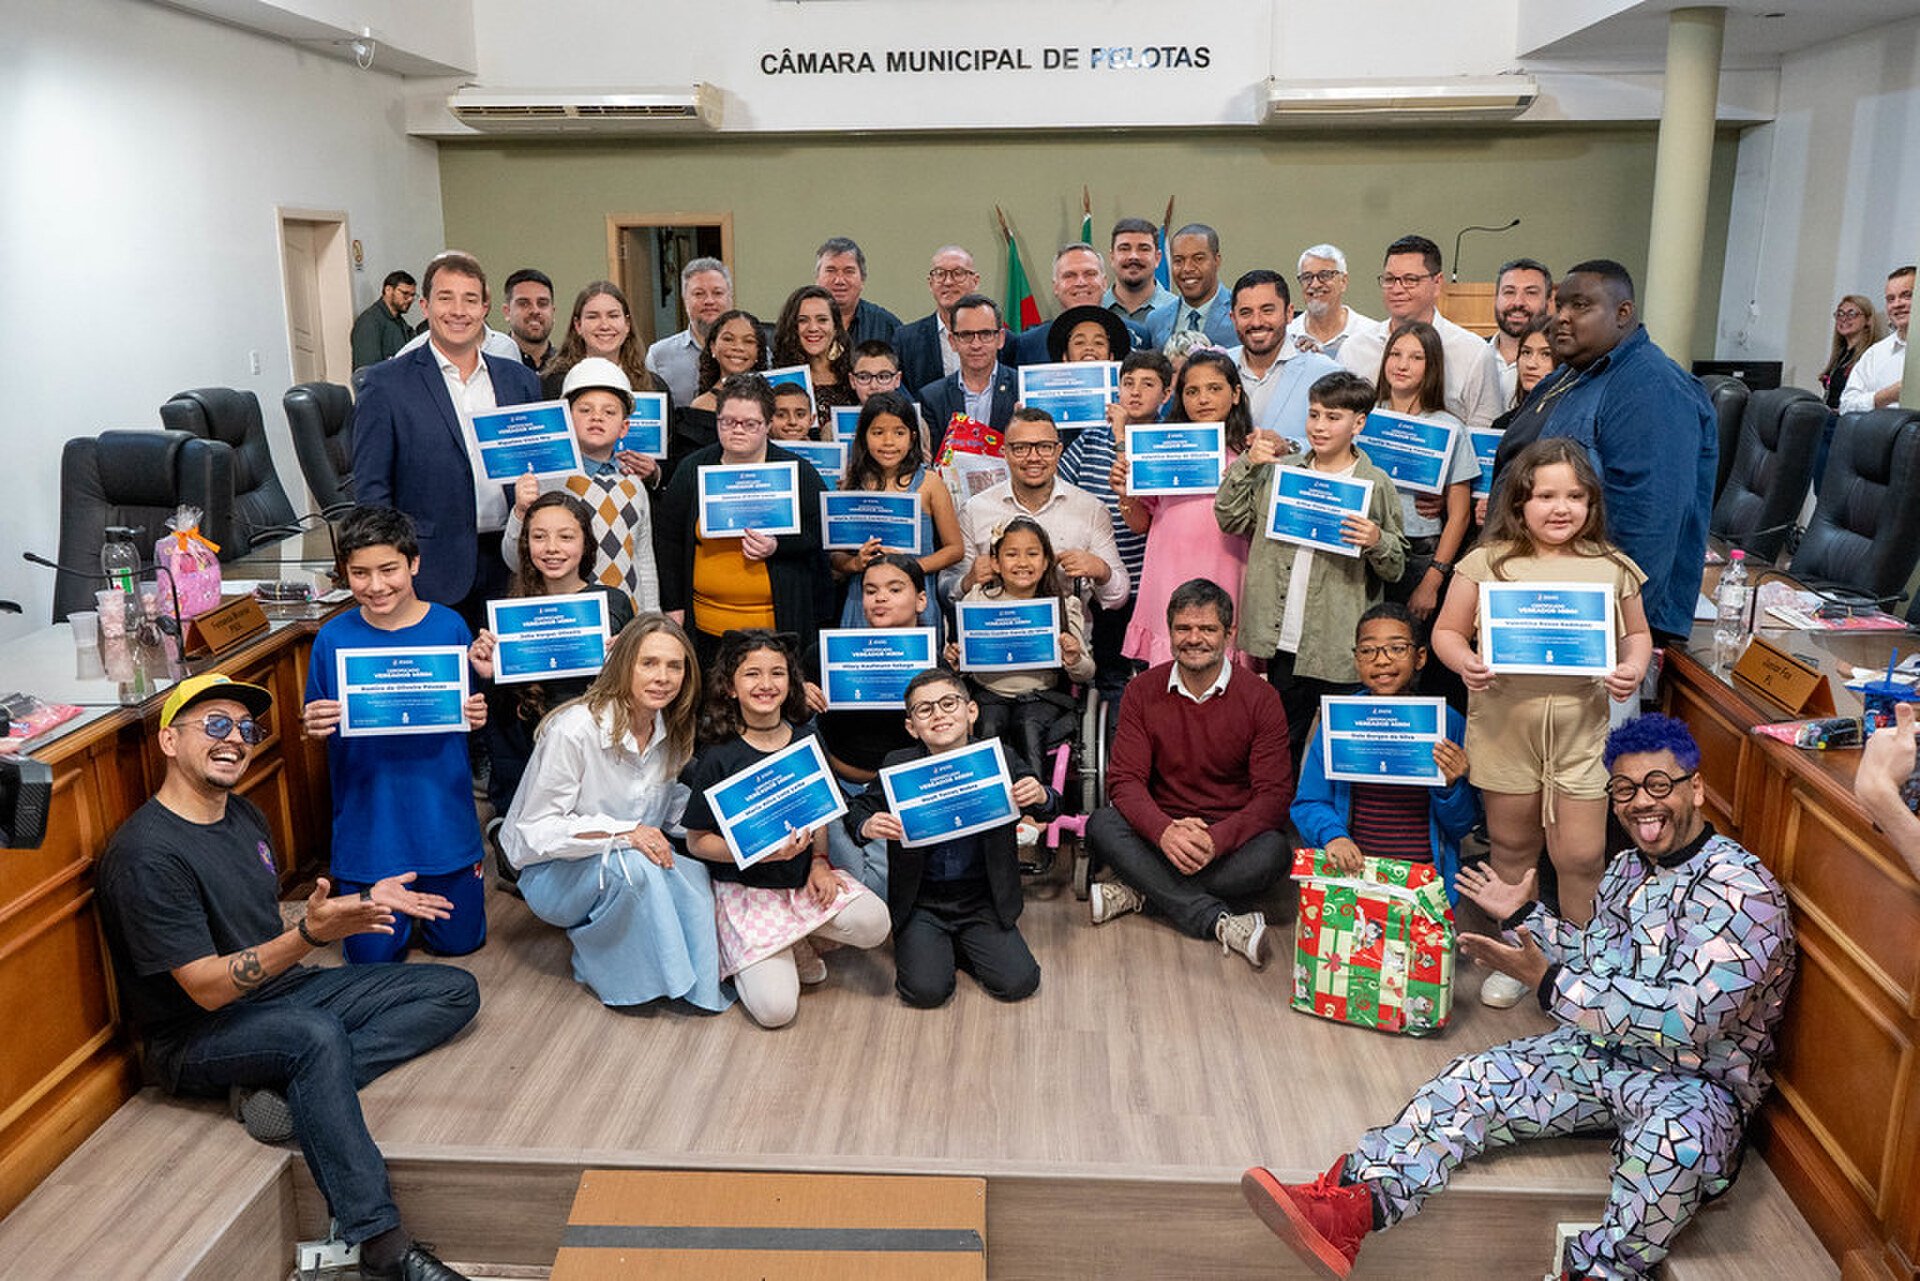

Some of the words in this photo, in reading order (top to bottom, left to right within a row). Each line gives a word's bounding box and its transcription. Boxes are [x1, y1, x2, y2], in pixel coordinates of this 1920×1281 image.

[760, 48, 875, 75] CÂMARA
[886, 49, 1032, 73] MUNICIPAL
[1043, 48, 1080, 70] DE
[1090, 46, 1211, 69] PELOTAS
